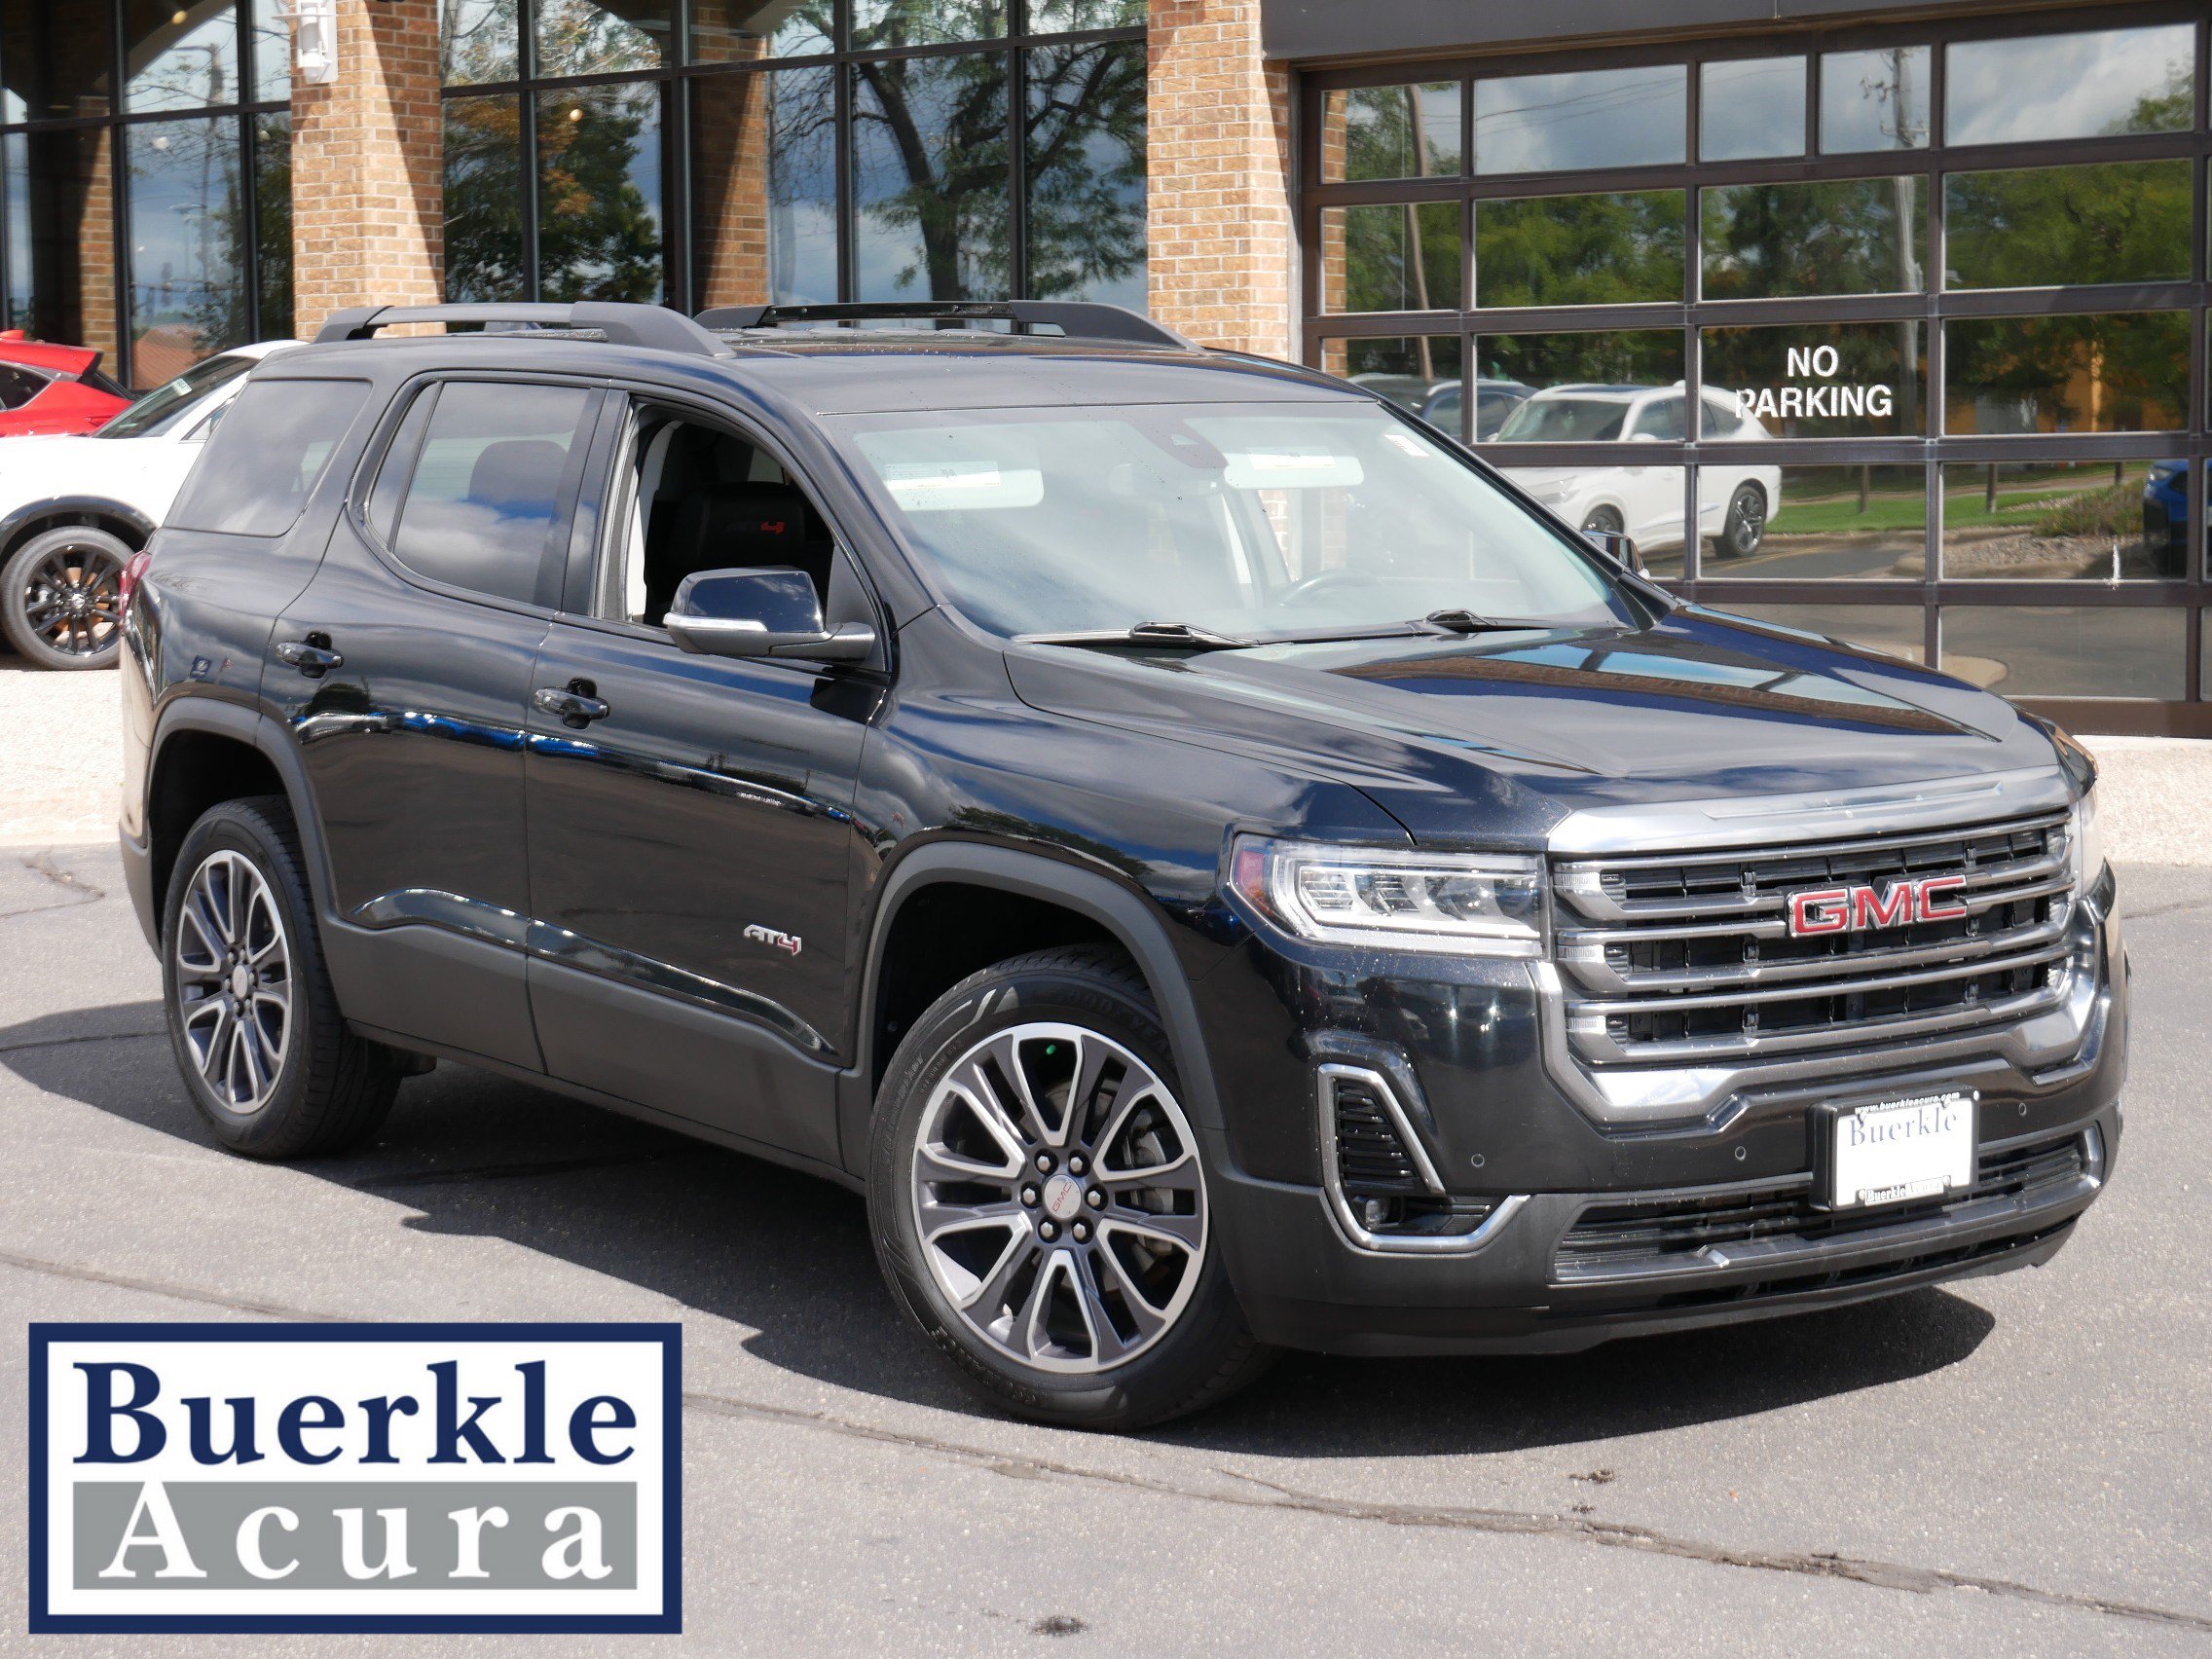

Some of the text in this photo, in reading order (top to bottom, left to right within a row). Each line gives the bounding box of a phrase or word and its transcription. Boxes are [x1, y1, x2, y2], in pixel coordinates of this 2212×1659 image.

[1788, 345, 1838, 377] NO
[1735, 384, 1892, 418] PARKING
[1789, 875, 1967, 937] GMC
[744, 924, 801, 955] AT4
[1855, 1091, 1960, 1115] www.buerkleacura.com
[1850, 1107, 1957, 1146] Buerkle
[1051, 1181, 1073, 1212] GMC
[1867, 1185, 1905, 1202] Buerkle
